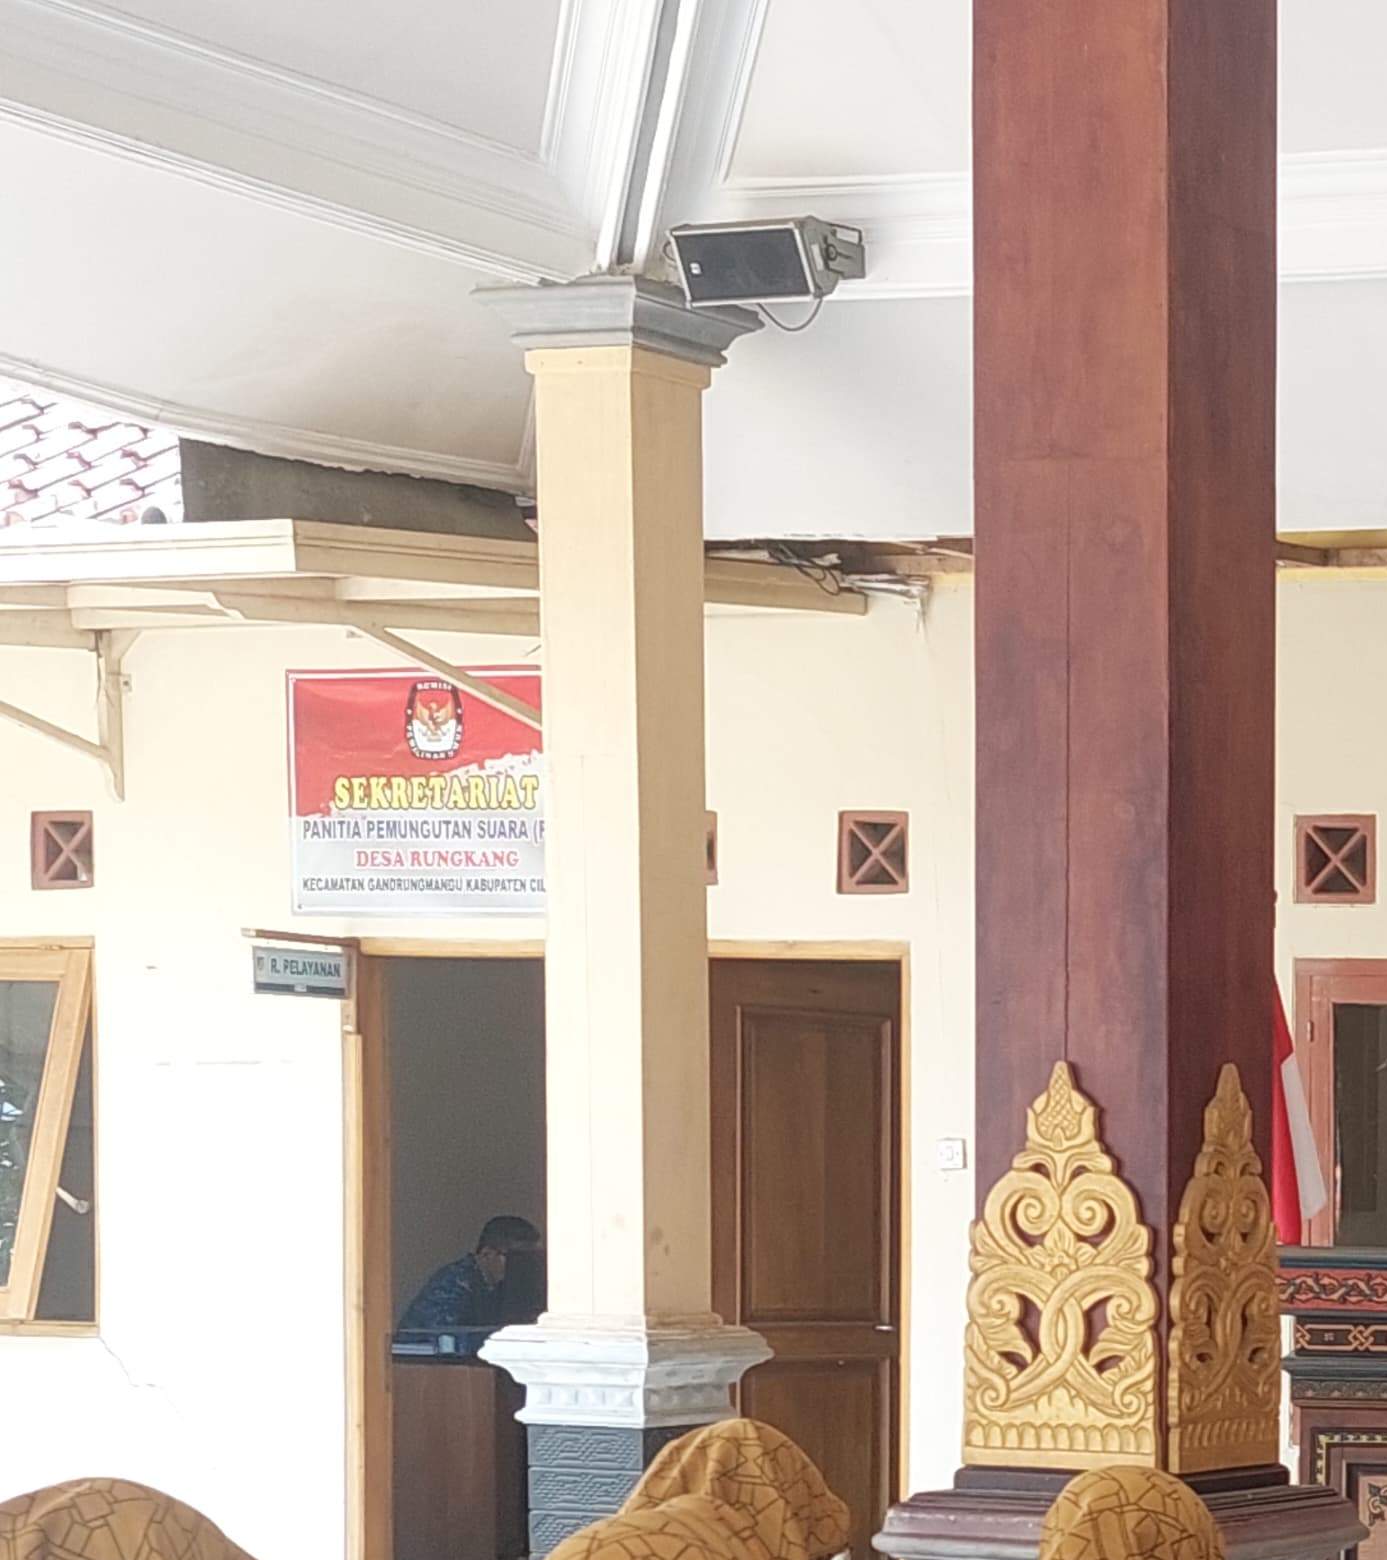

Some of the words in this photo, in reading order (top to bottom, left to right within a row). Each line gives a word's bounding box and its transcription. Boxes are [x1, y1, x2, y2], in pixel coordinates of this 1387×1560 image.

[333, 774, 540, 811] SEKRETARIAT
[303, 820, 362, 840] PANITIA
[366, 820, 472, 840] PEMUNGUTAN
[477, 820, 529, 840] SUARA
[356, 850, 405, 868] DESA
[410, 850, 520, 868] RUNGKANG
[302, 877, 365, 892] KECAMATAN
[466, 878, 526, 893] KABUPATEN
[270, 958, 281, 974] R.
[283, 959, 342, 978] PELAYANAN
